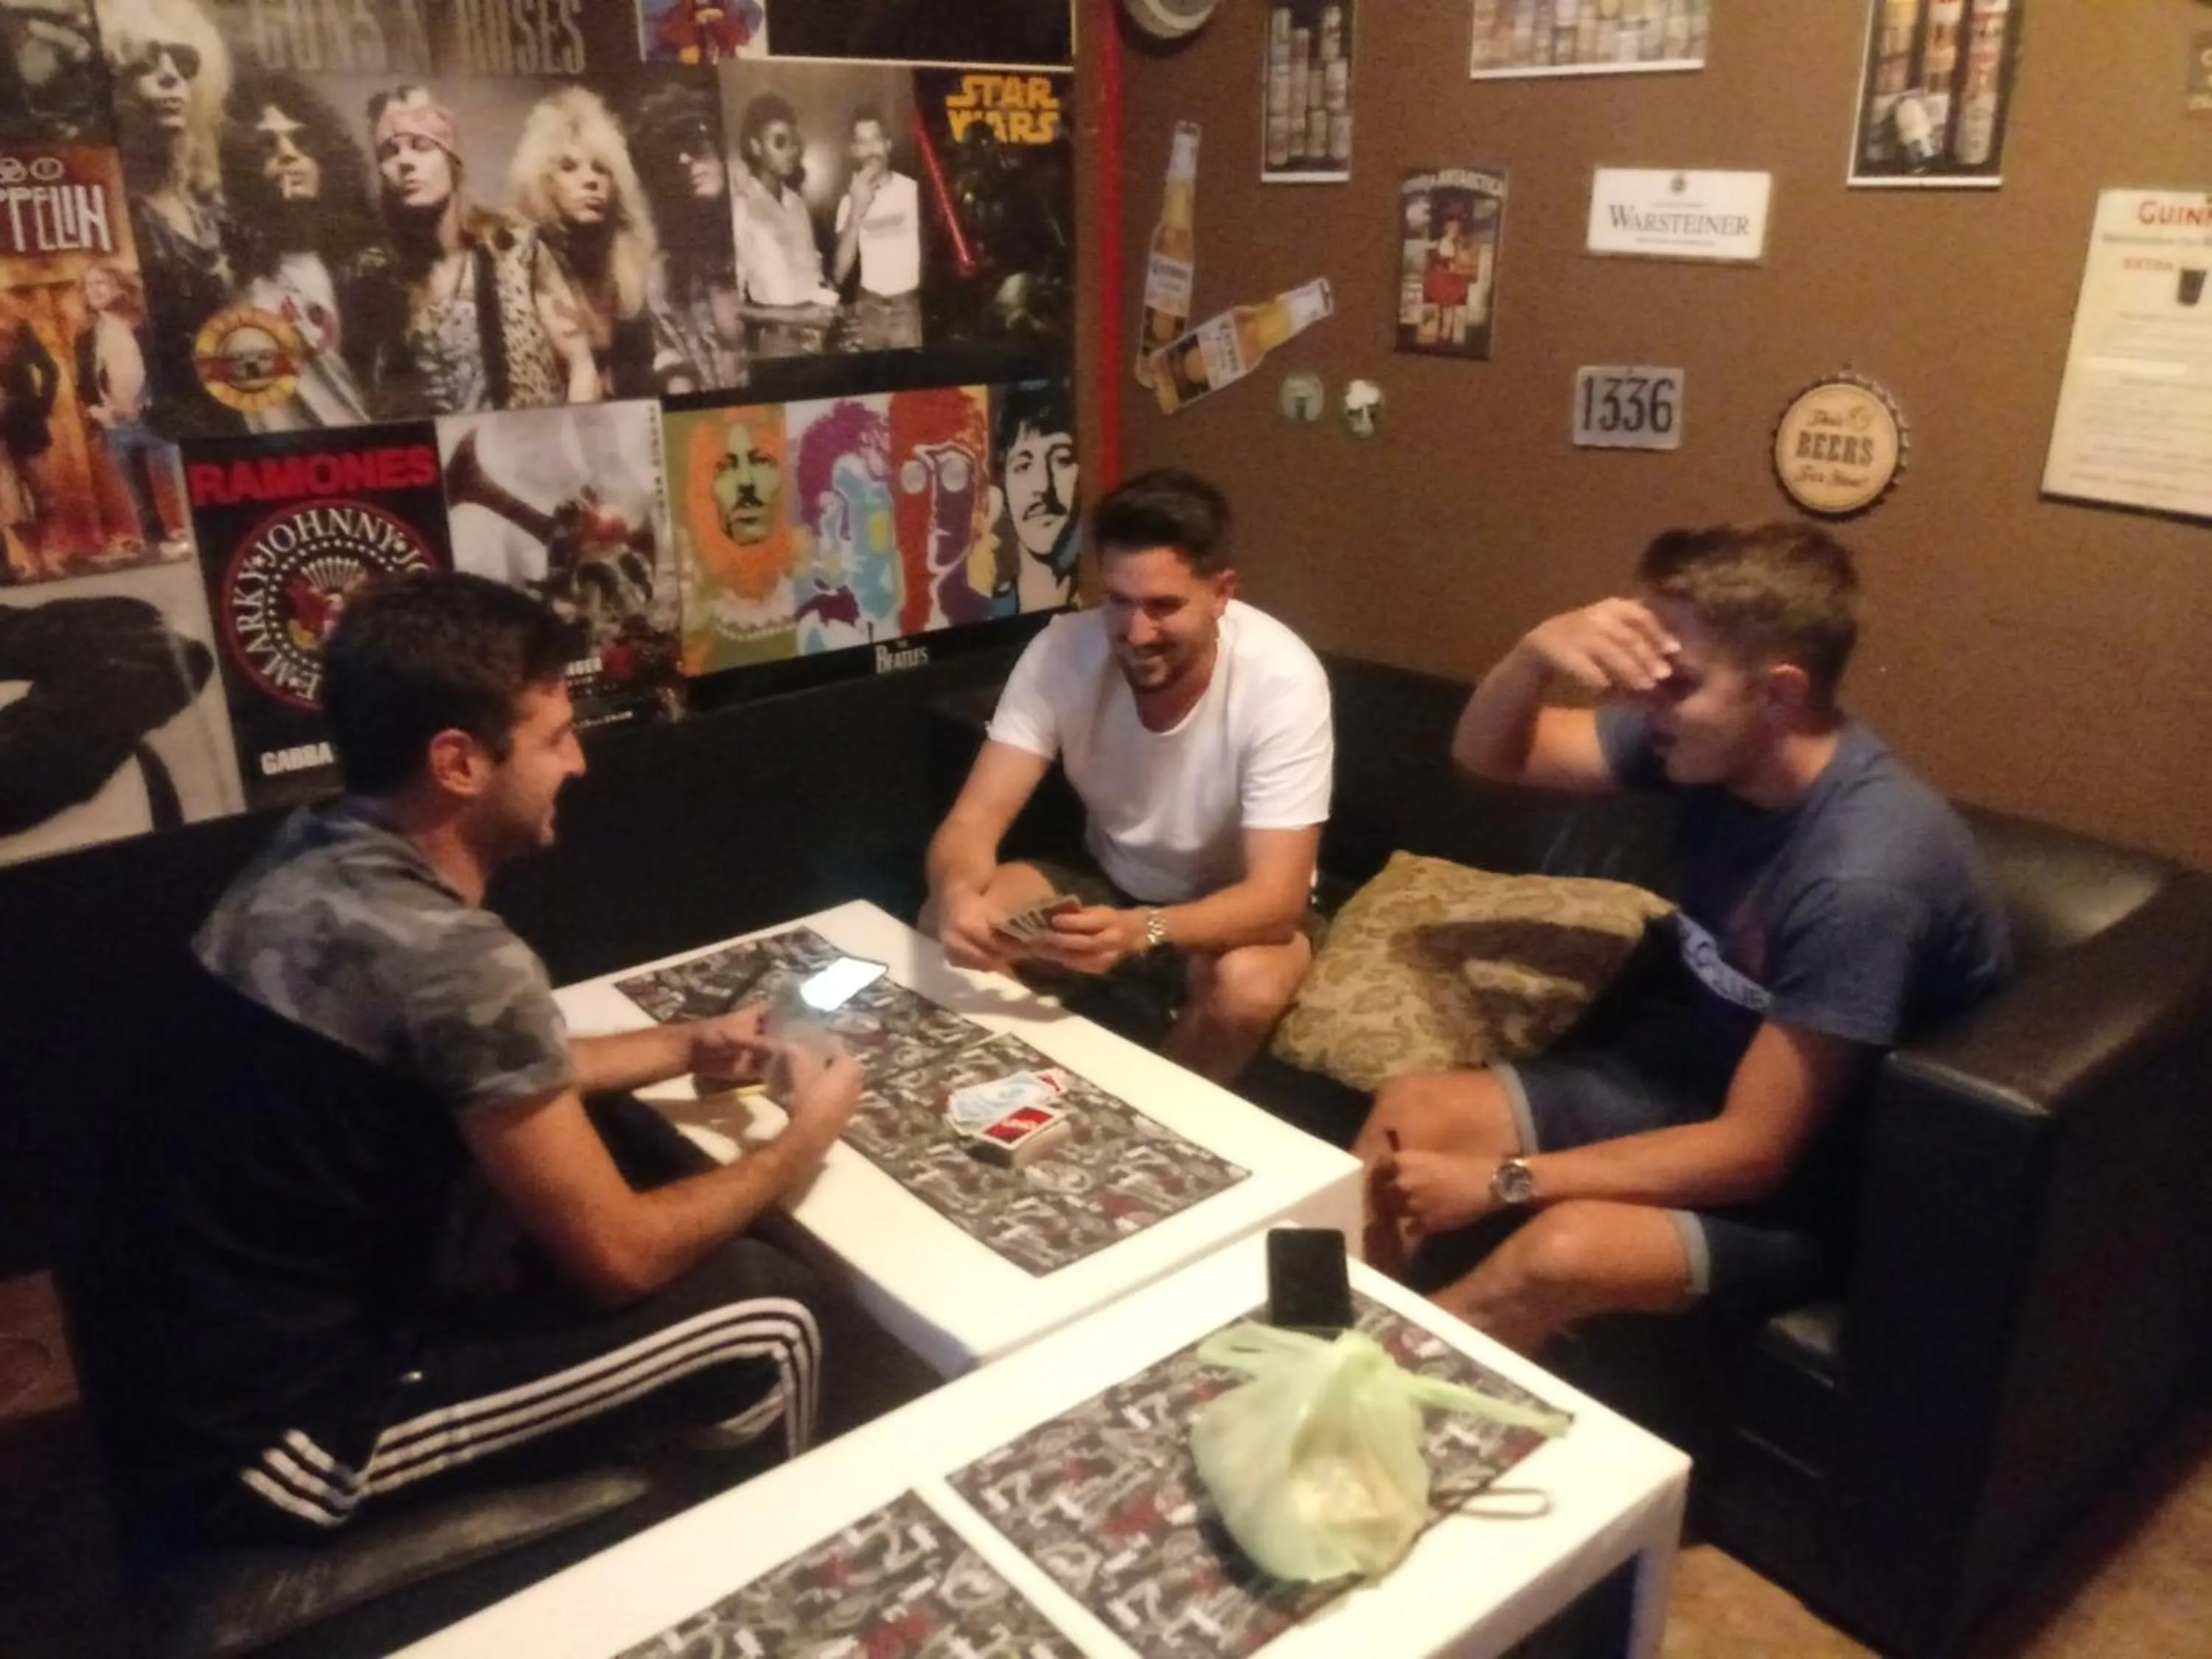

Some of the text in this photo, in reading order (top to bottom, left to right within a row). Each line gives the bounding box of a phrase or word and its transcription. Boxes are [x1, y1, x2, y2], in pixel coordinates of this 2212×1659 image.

[945, 74, 1060, 108] STAR
[946, 110, 1060, 143] WARS
[1608, 204, 1750, 237] WARSTEINER
[1582, 375, 1675, 434] 1336
[1795, 430, 1874, 468] BEERS
[188, 445, 437, 507] RAMONES
[254, 507, 403, 568] JOHNNY
[260, 741, 335, 776] GABBA
